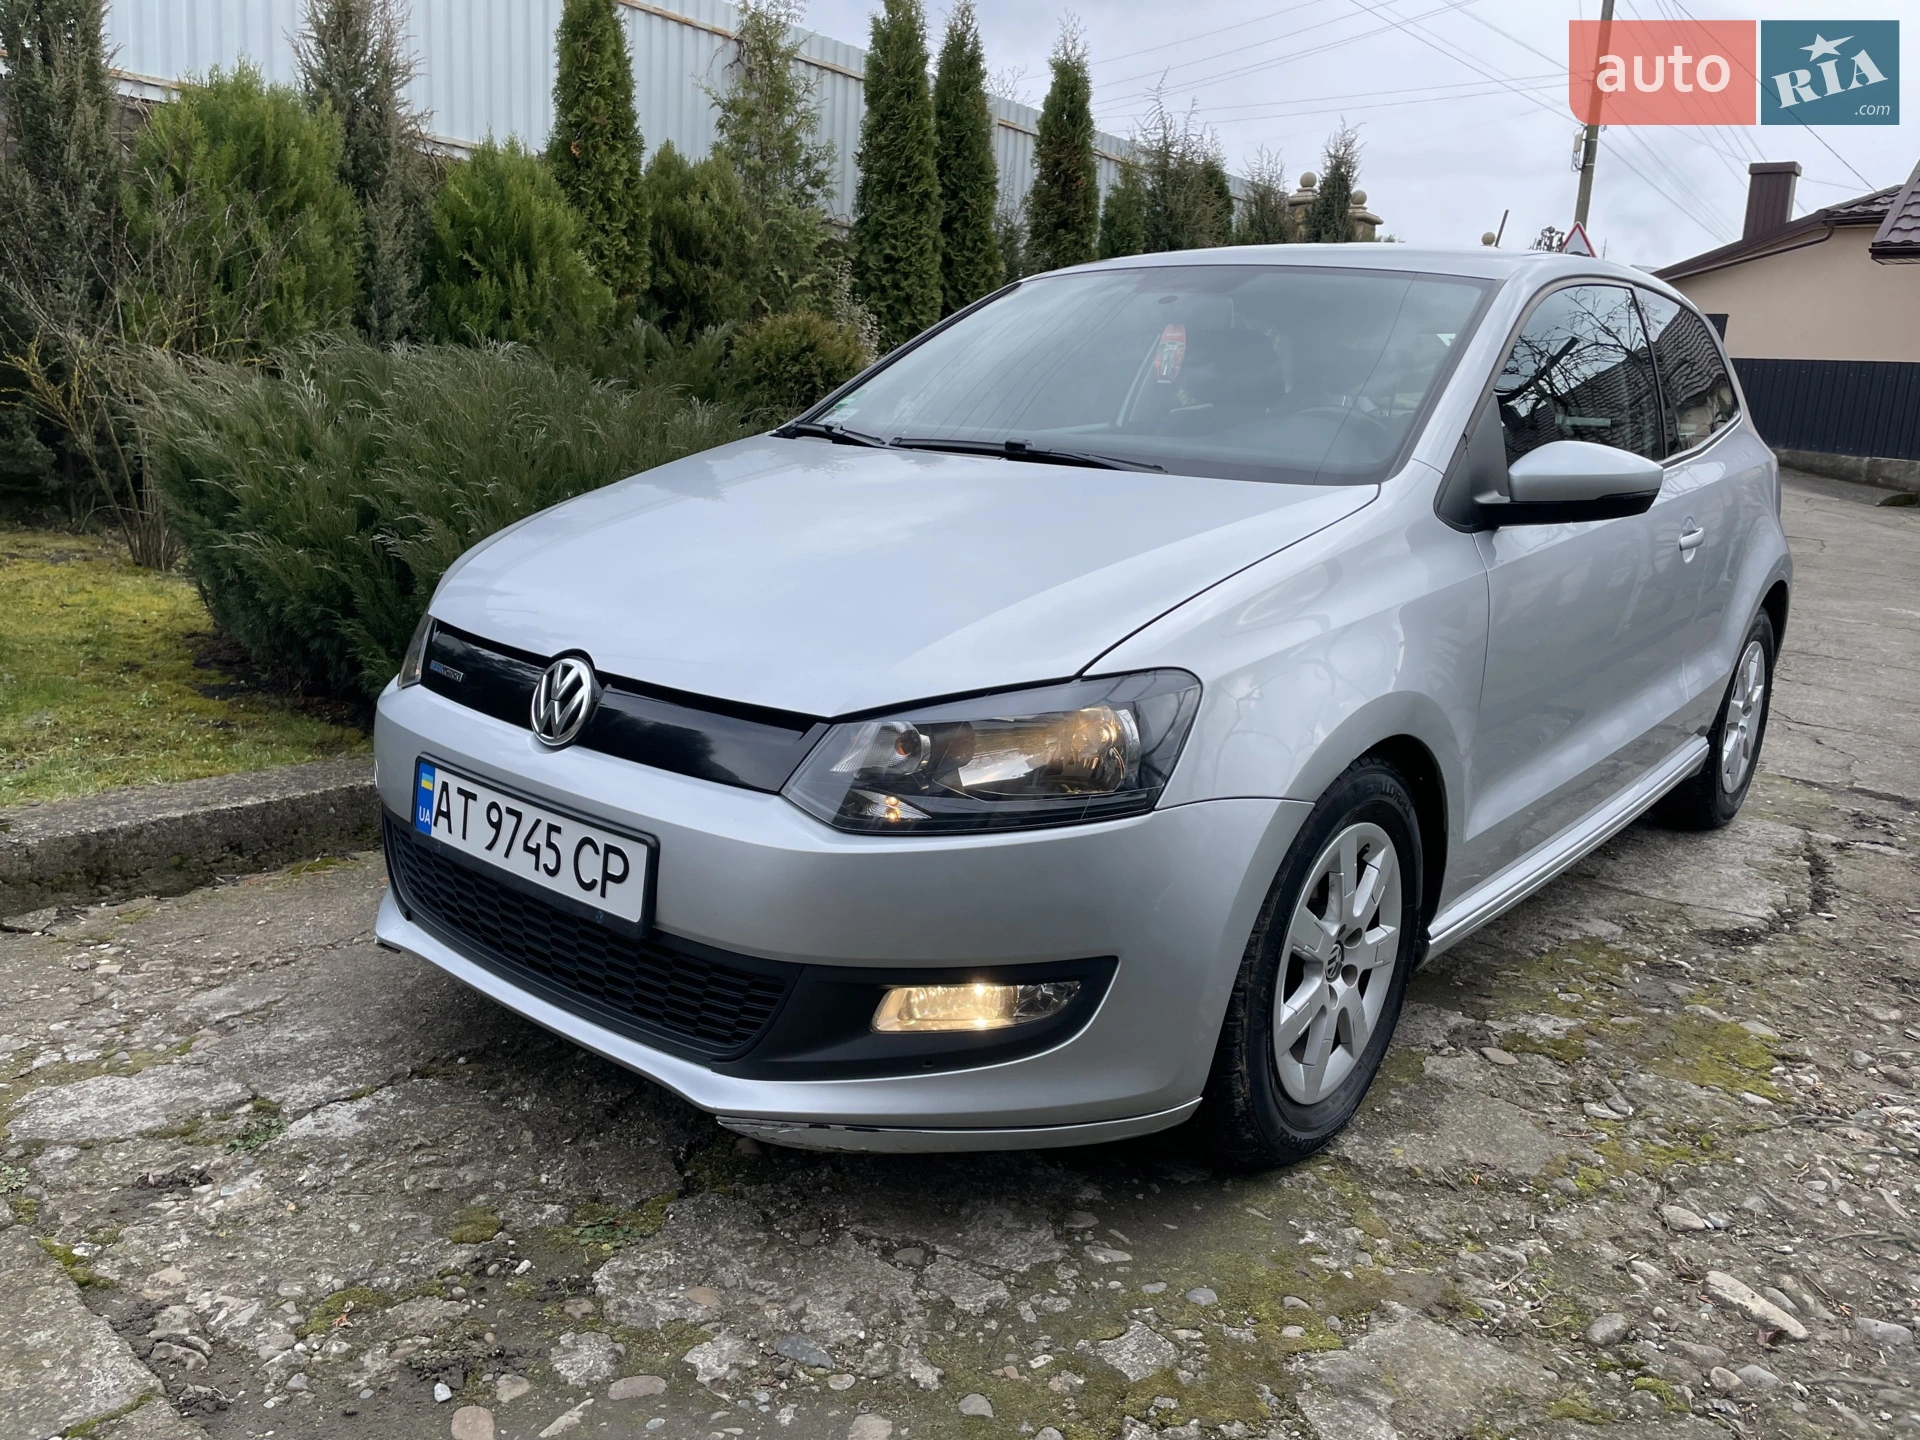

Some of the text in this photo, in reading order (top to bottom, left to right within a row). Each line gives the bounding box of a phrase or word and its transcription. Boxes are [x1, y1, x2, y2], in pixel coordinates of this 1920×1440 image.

[418, 806, 431, 825] UA
[433, 780, 630, 898] AT 9745 CP
